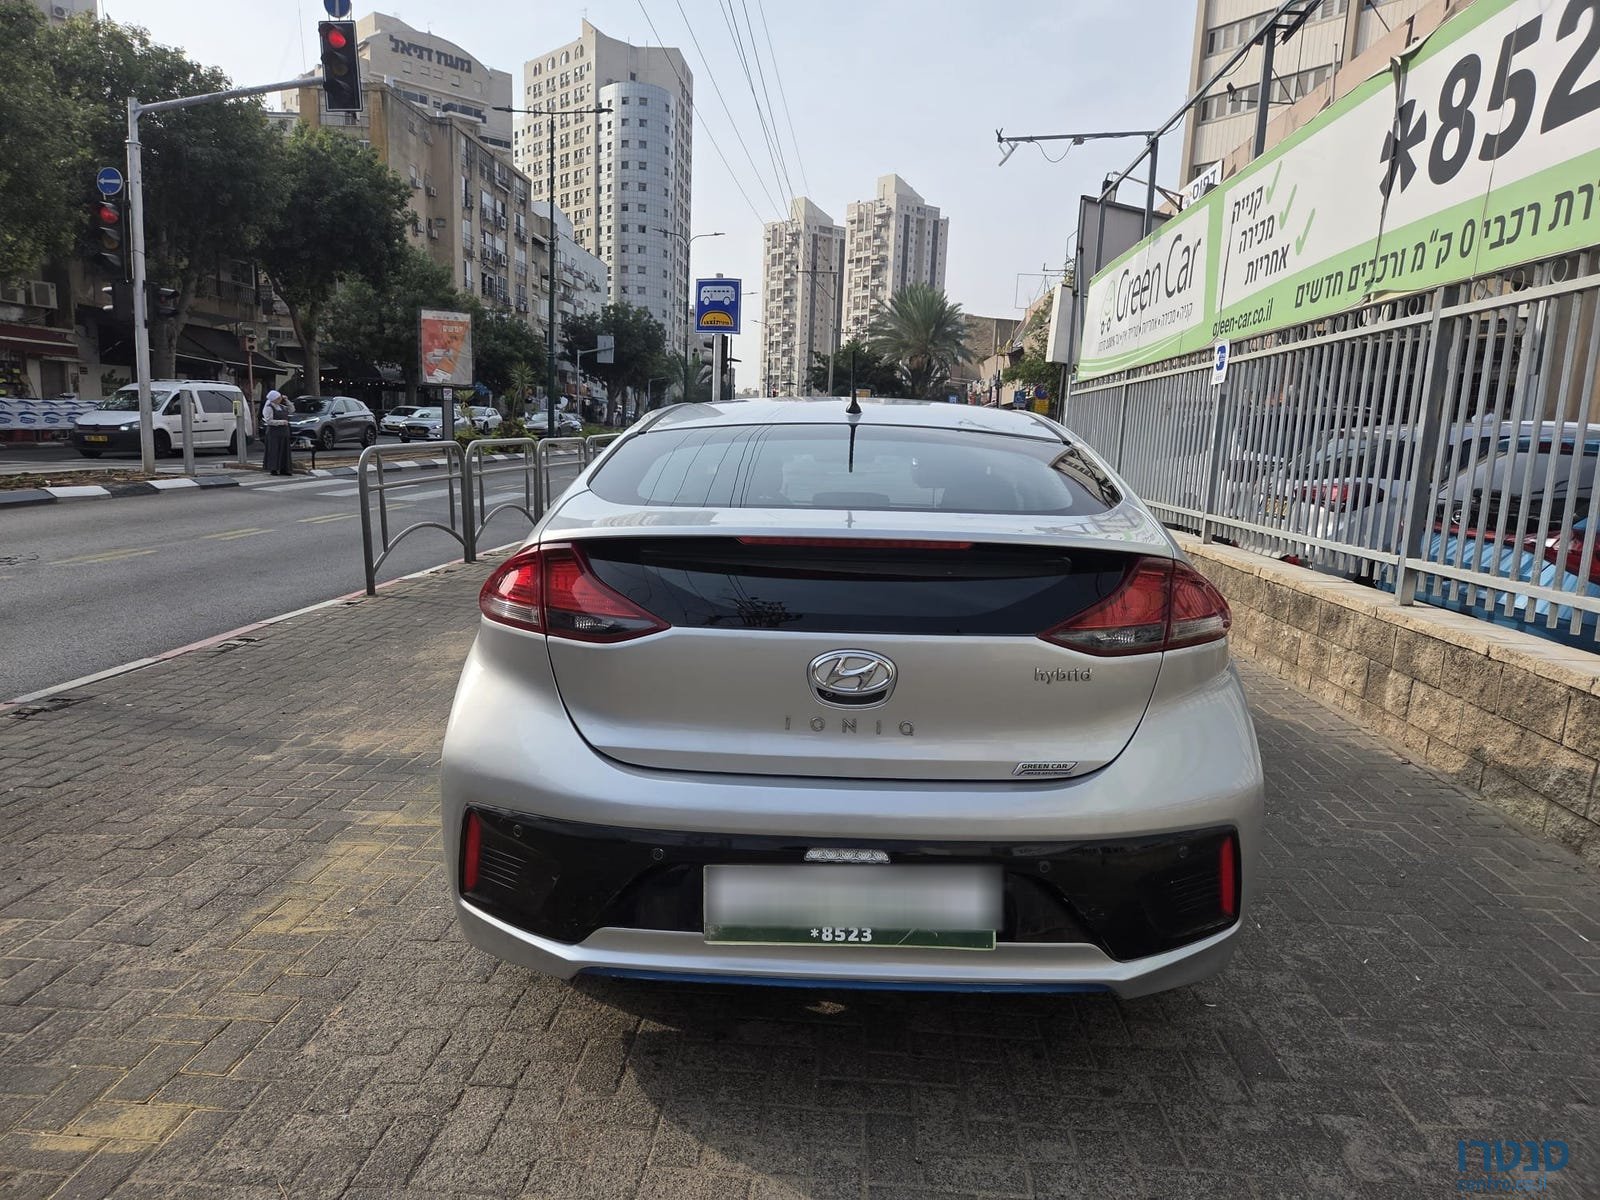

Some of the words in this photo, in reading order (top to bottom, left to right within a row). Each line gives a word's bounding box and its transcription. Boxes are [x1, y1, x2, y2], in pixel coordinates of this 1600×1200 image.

[389, 34, 434, 62] דניאל
[1232, 186, 1263, 225] קנייה
[1548, 178, 1600, 232] רת
[1239, 215, 1275, 254] מכירה
[1460, 218, 1475, 258] 0
[1483, 202, 1541, 250] רכבי
[1116, 262, 1161, 322] Green
[1165, 233, 1202, 298] Car
[1244, 243, 1290, 285] אחריות
[1347, 247, 1406, 293] ורכבים
[1294, 270, 1344, 309] חדשים
[1034, 668, 1093, 684] hybrid
[784, 715, 915, 737] IONIQ
